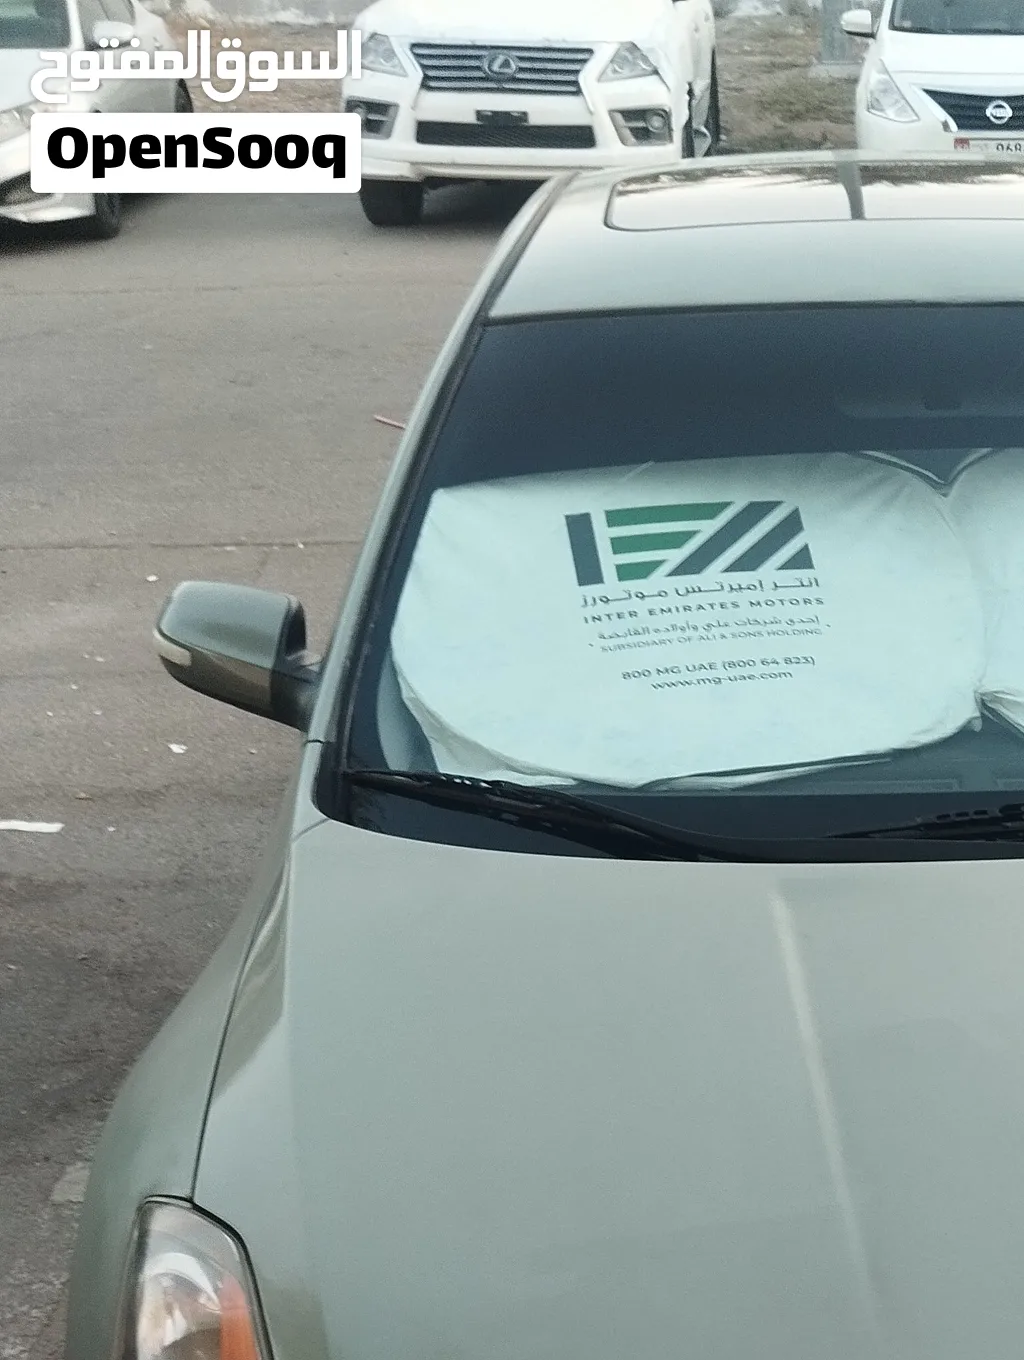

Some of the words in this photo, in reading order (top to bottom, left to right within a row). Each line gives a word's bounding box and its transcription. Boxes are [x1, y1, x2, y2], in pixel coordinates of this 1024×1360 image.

[581, 589, 669, 608] موتورز
[583, 610, 639, 624] INTER
[647, 600, 740, 616] EMIRATES
[748, 597, 824, 608] MOTORS
[600, 638, 674, 652] SUBSIDIARY
[676, 635, 692, 644] OF
[699, 634, 716, 642] ALI
[731, 630, 764, 639] SONS
[766, 628, 822, 638] HOLDING
[621, 668, 652, 681] 800
[655, 665, 681, 677] MG
[685, 661, 719, 673] UAE
[721, 658, 757, 672] (800
[760, 657, 780, 667] 64
[783, 655, 816, 667] 823)
[651, 670, 793, 691] www.mg-uae.com
